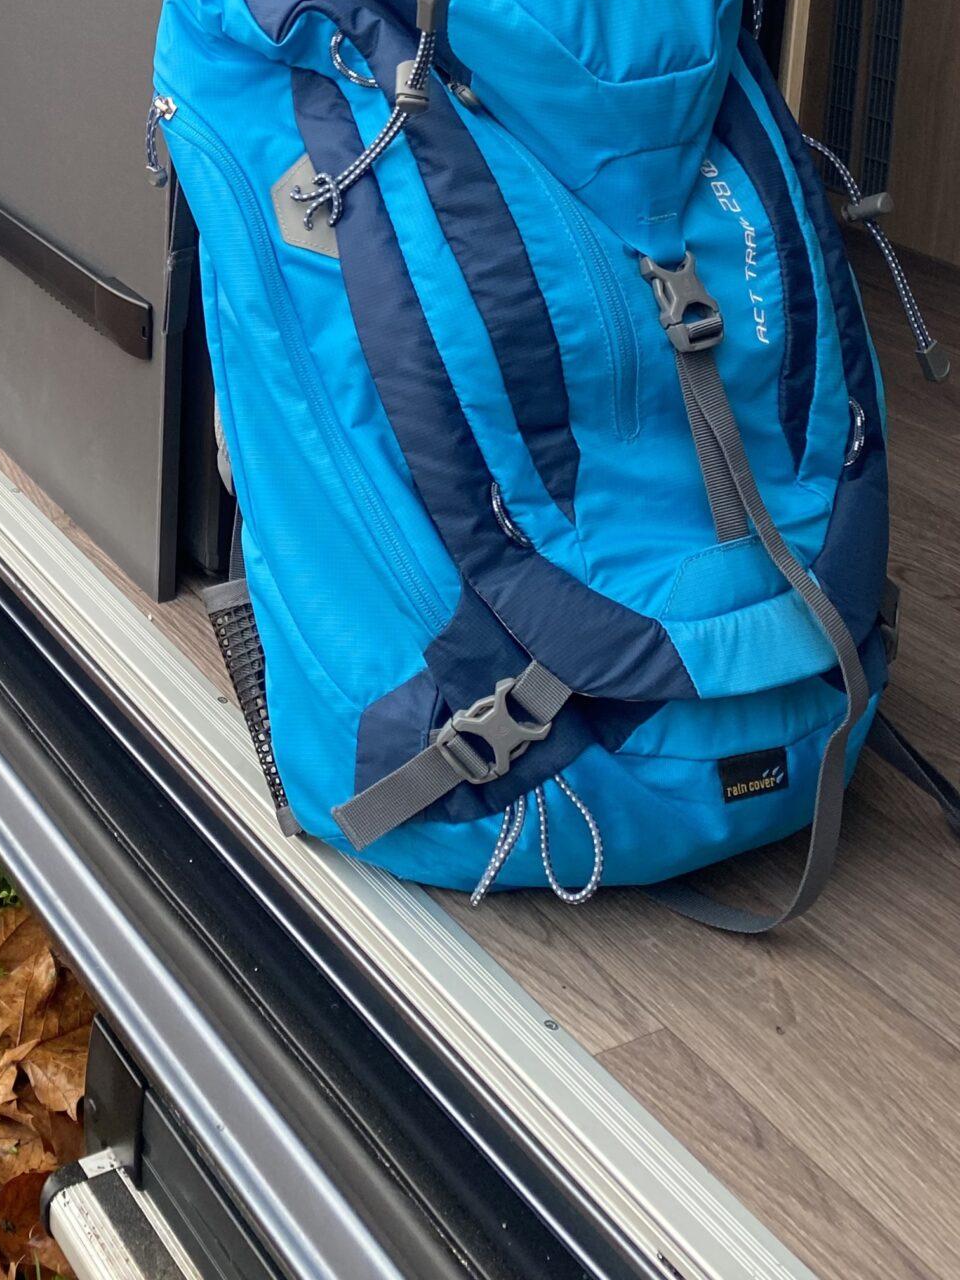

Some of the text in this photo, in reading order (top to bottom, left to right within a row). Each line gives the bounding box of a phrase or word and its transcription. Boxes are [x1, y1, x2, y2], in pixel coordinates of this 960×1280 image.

[710, 181, 741, 213] 28
[749, 290, 769, 344] ACT
[726, 777, 776, 797] rain cover
